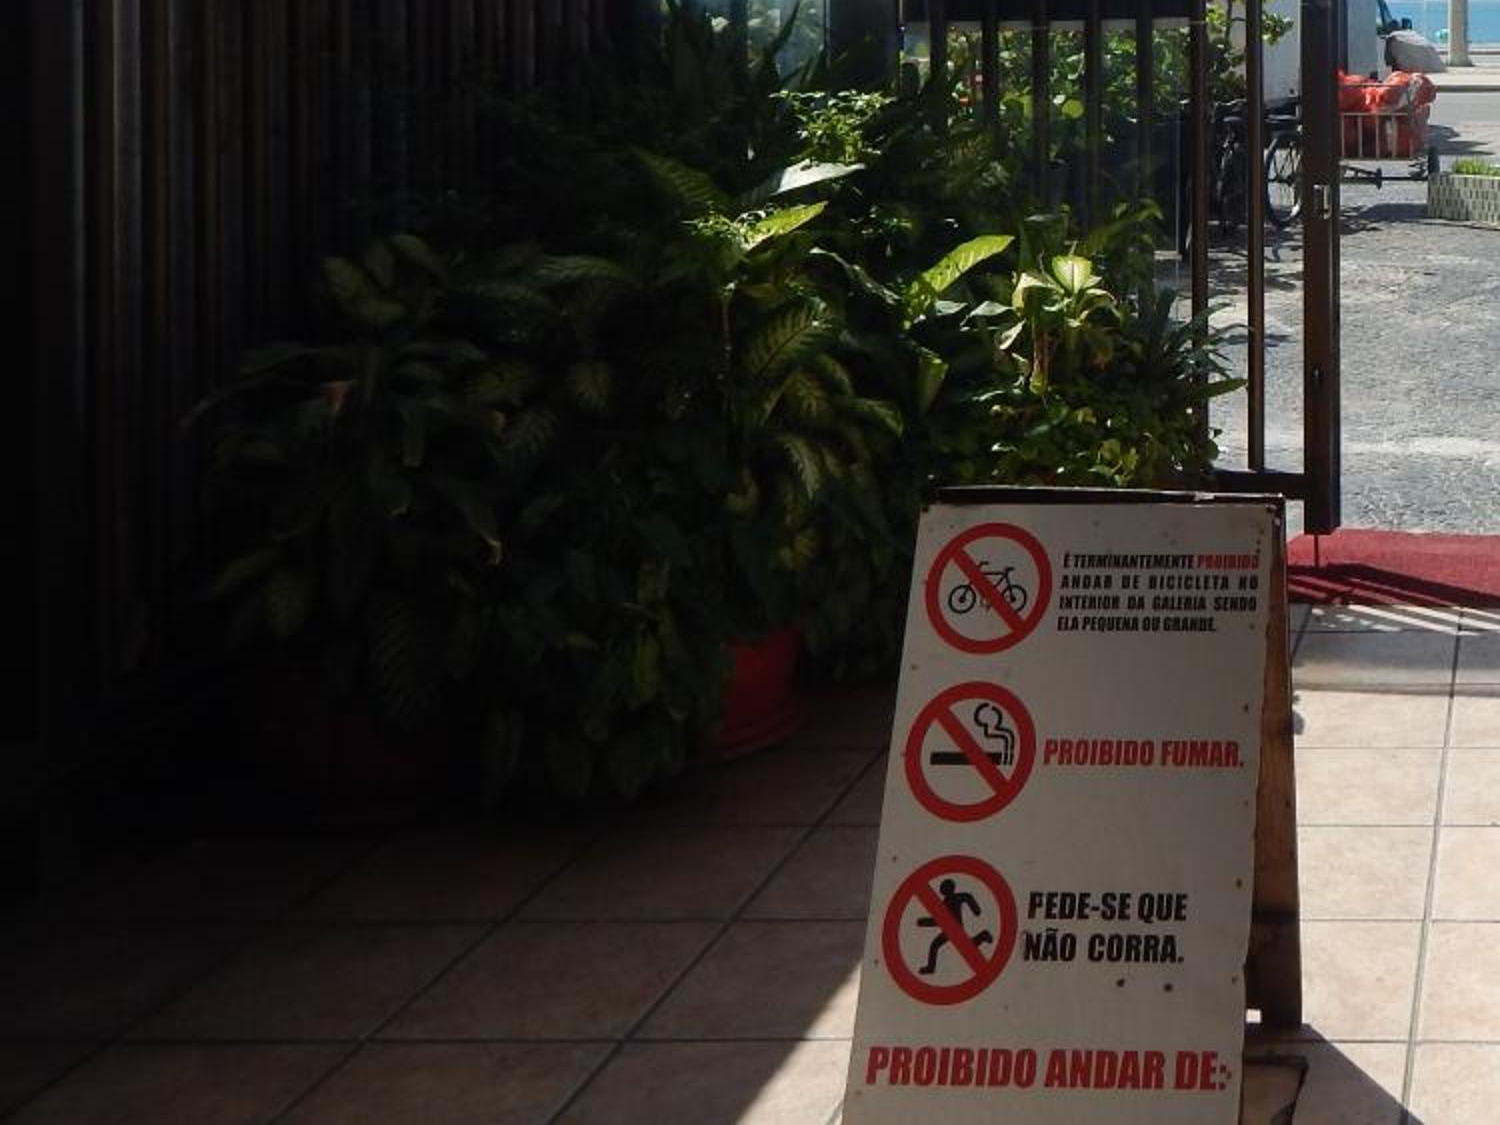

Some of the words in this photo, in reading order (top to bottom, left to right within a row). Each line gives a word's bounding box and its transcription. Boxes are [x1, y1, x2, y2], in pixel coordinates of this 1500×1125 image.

[1060, 574, 1112, 589] ANDAR
[1121, 574, 1140, 589] DE
[1148, 574, 1229, 590] BICICLETA
[1238, 575, 1259, 590] NO
[1059, 595, 1120, 610] INTERIOR
[1127, 595, 1145, 610] DA
[1152, 595, 1207, 611] GALERIA
[1213, 596, 1257, 612] SENDO
[1057, 616, 1080, 631] ELA
[1081, 616, 1139, 633] PEQUENA
[1141, 616, 1160, 631] OU
[1043, 738, 1154, 767] PROIBIDO
[1159, 740, 1245, 768] FUMAR.
[1027, 891, 1132, 921] PEDE-SE
[1137, 892, 1188, 924] QUE
[1023, 928, 1077, 962] NÃO
[1087, 933, 1184, 964] CORRA.
[865, 1046, 1038, 1088] PROIBIDO
[1043, 1049, 1165, 1089] ANDAR
[1173, 1050, 1227, 1092] DE:
